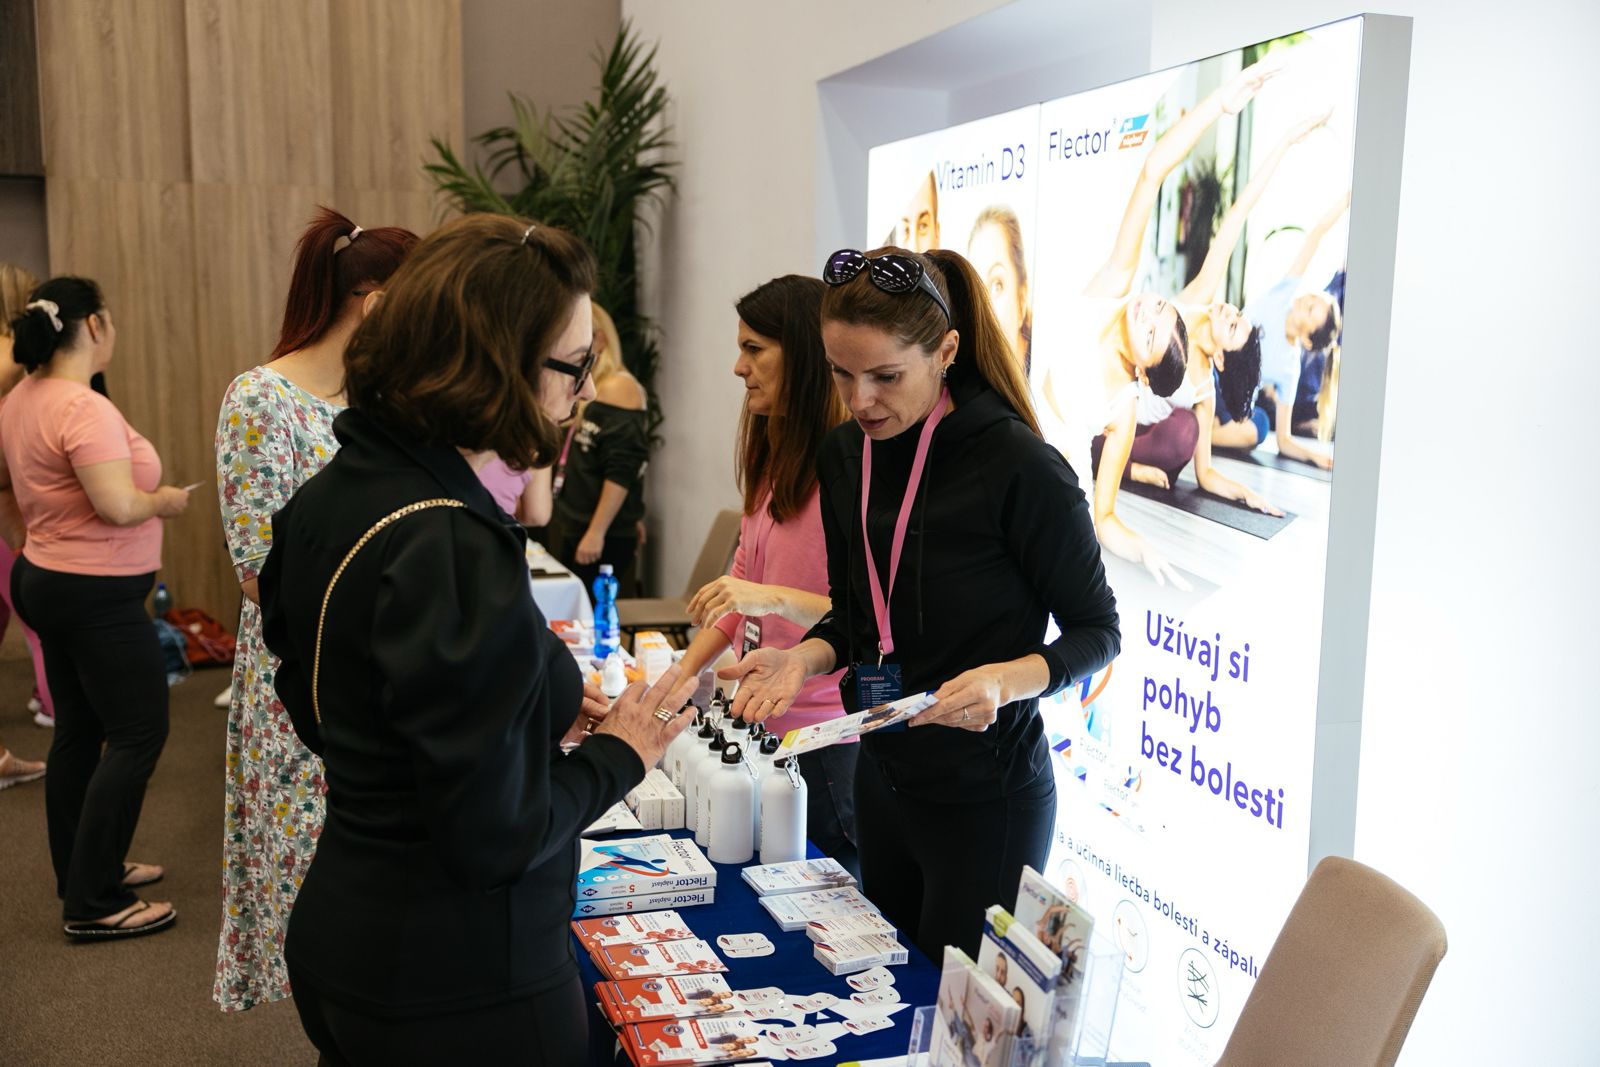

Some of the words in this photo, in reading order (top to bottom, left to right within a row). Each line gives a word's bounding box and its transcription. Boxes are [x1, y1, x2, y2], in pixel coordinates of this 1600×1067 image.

[1001, 143, 1026, 181] D3
[1048, 128, 1111, 161] Flector
[1146, 609, 1221, 682] Užívaj
[1228, 642, 1250, 682] si
[1143, 676, 1222, 733] pohyb
[1141, 720, 1182, 775] bez
[1190, 744, 1285, 829] bolesti
[626, 901, 633, 910] 5
[672, 893, 705, 904] Flector
[628, 884, 635, 893] 5
[675, 876, 708, 887] Flector
[1076, 839, 1112, 876] účinná
[1114, 863, 1150, 903] liečba
[1153, 889, 1198, 938] bolesti
[1201, 930, 1209, 946] a
